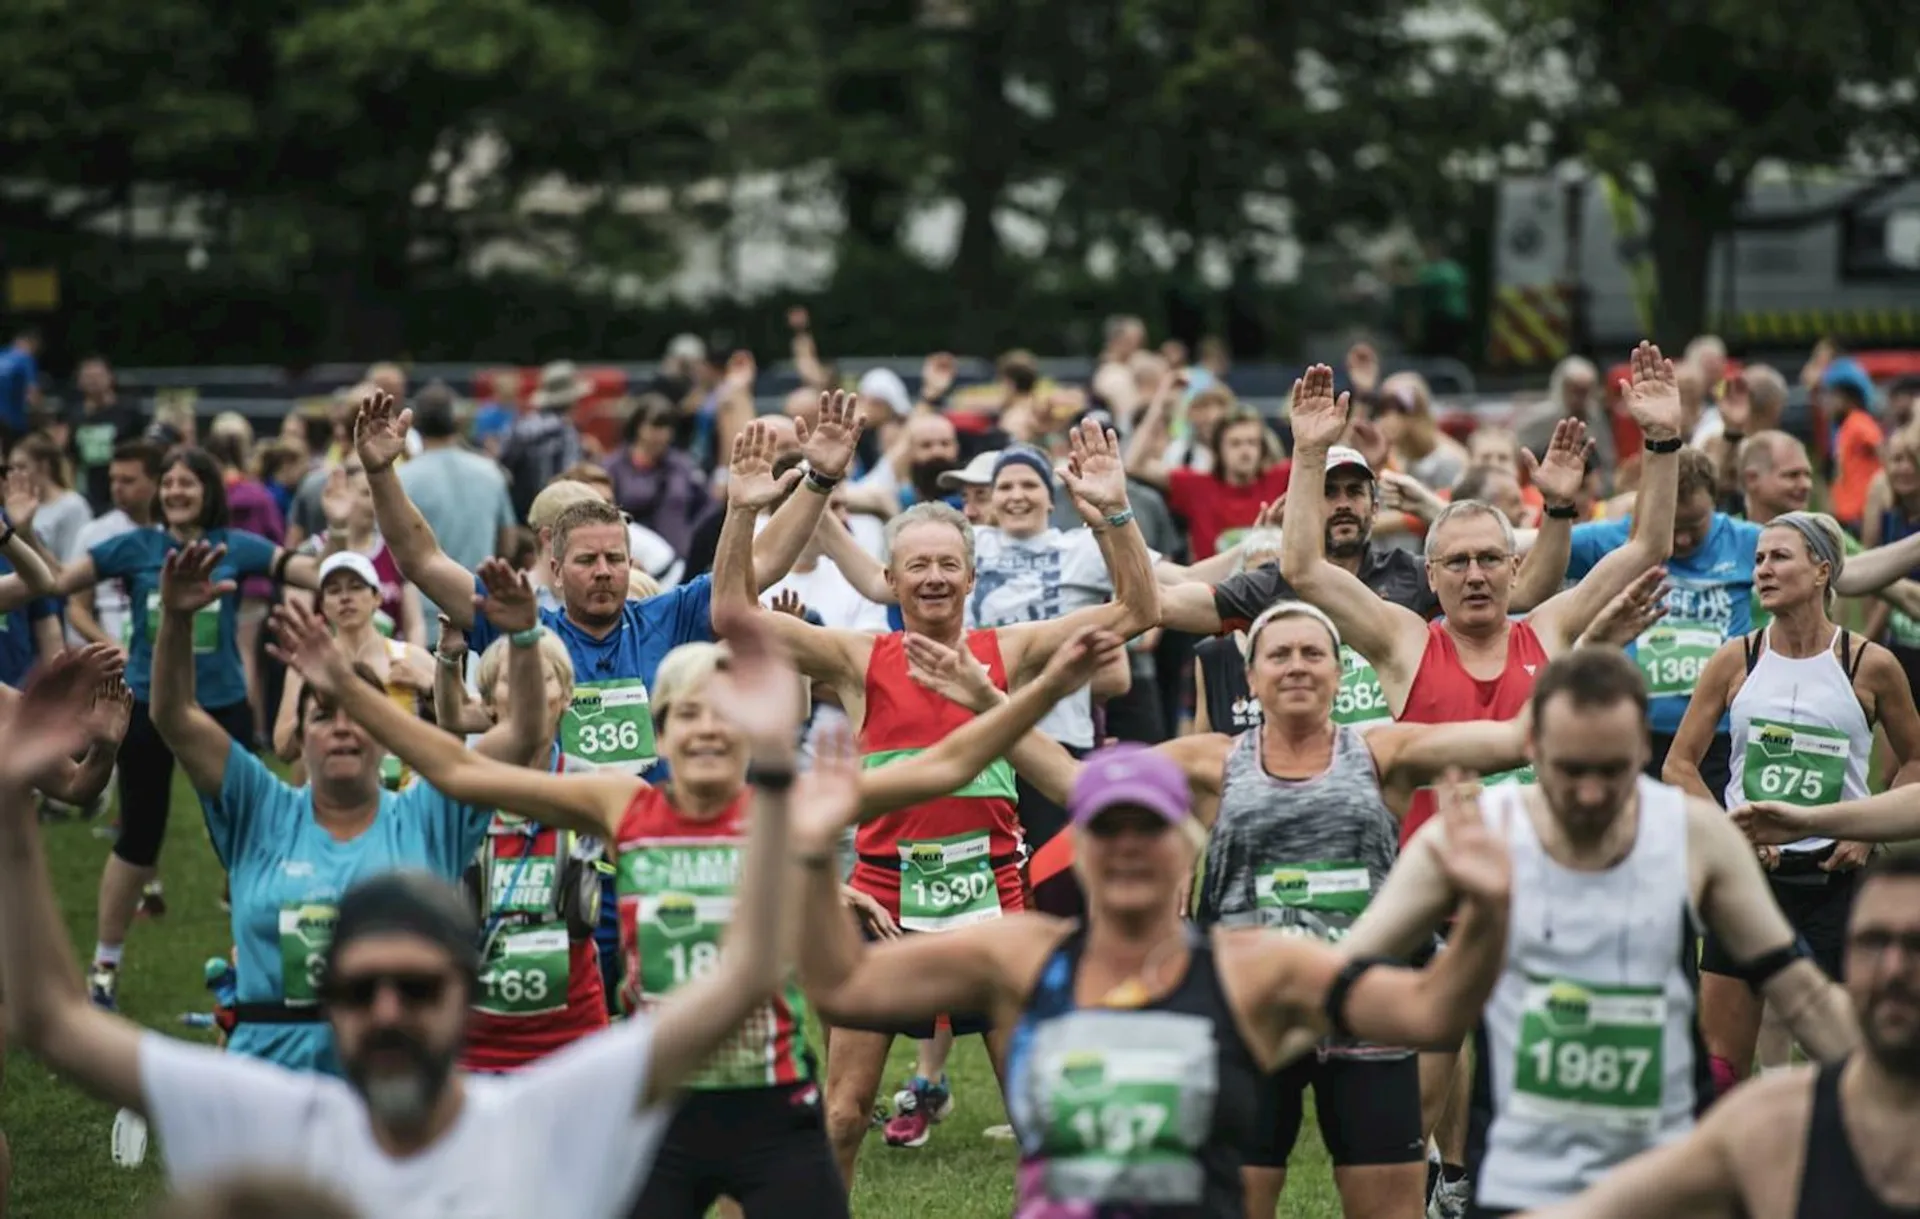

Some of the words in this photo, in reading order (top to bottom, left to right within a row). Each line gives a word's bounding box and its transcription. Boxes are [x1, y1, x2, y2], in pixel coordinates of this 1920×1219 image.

[578, 721, 639, 754] 336
[1761, 763, 1824, 800] 675
[911, 872, 988, 908] 1930
[664, 940, 723, 985] 18
[1530, 1038, 1653, 1094] 1987
